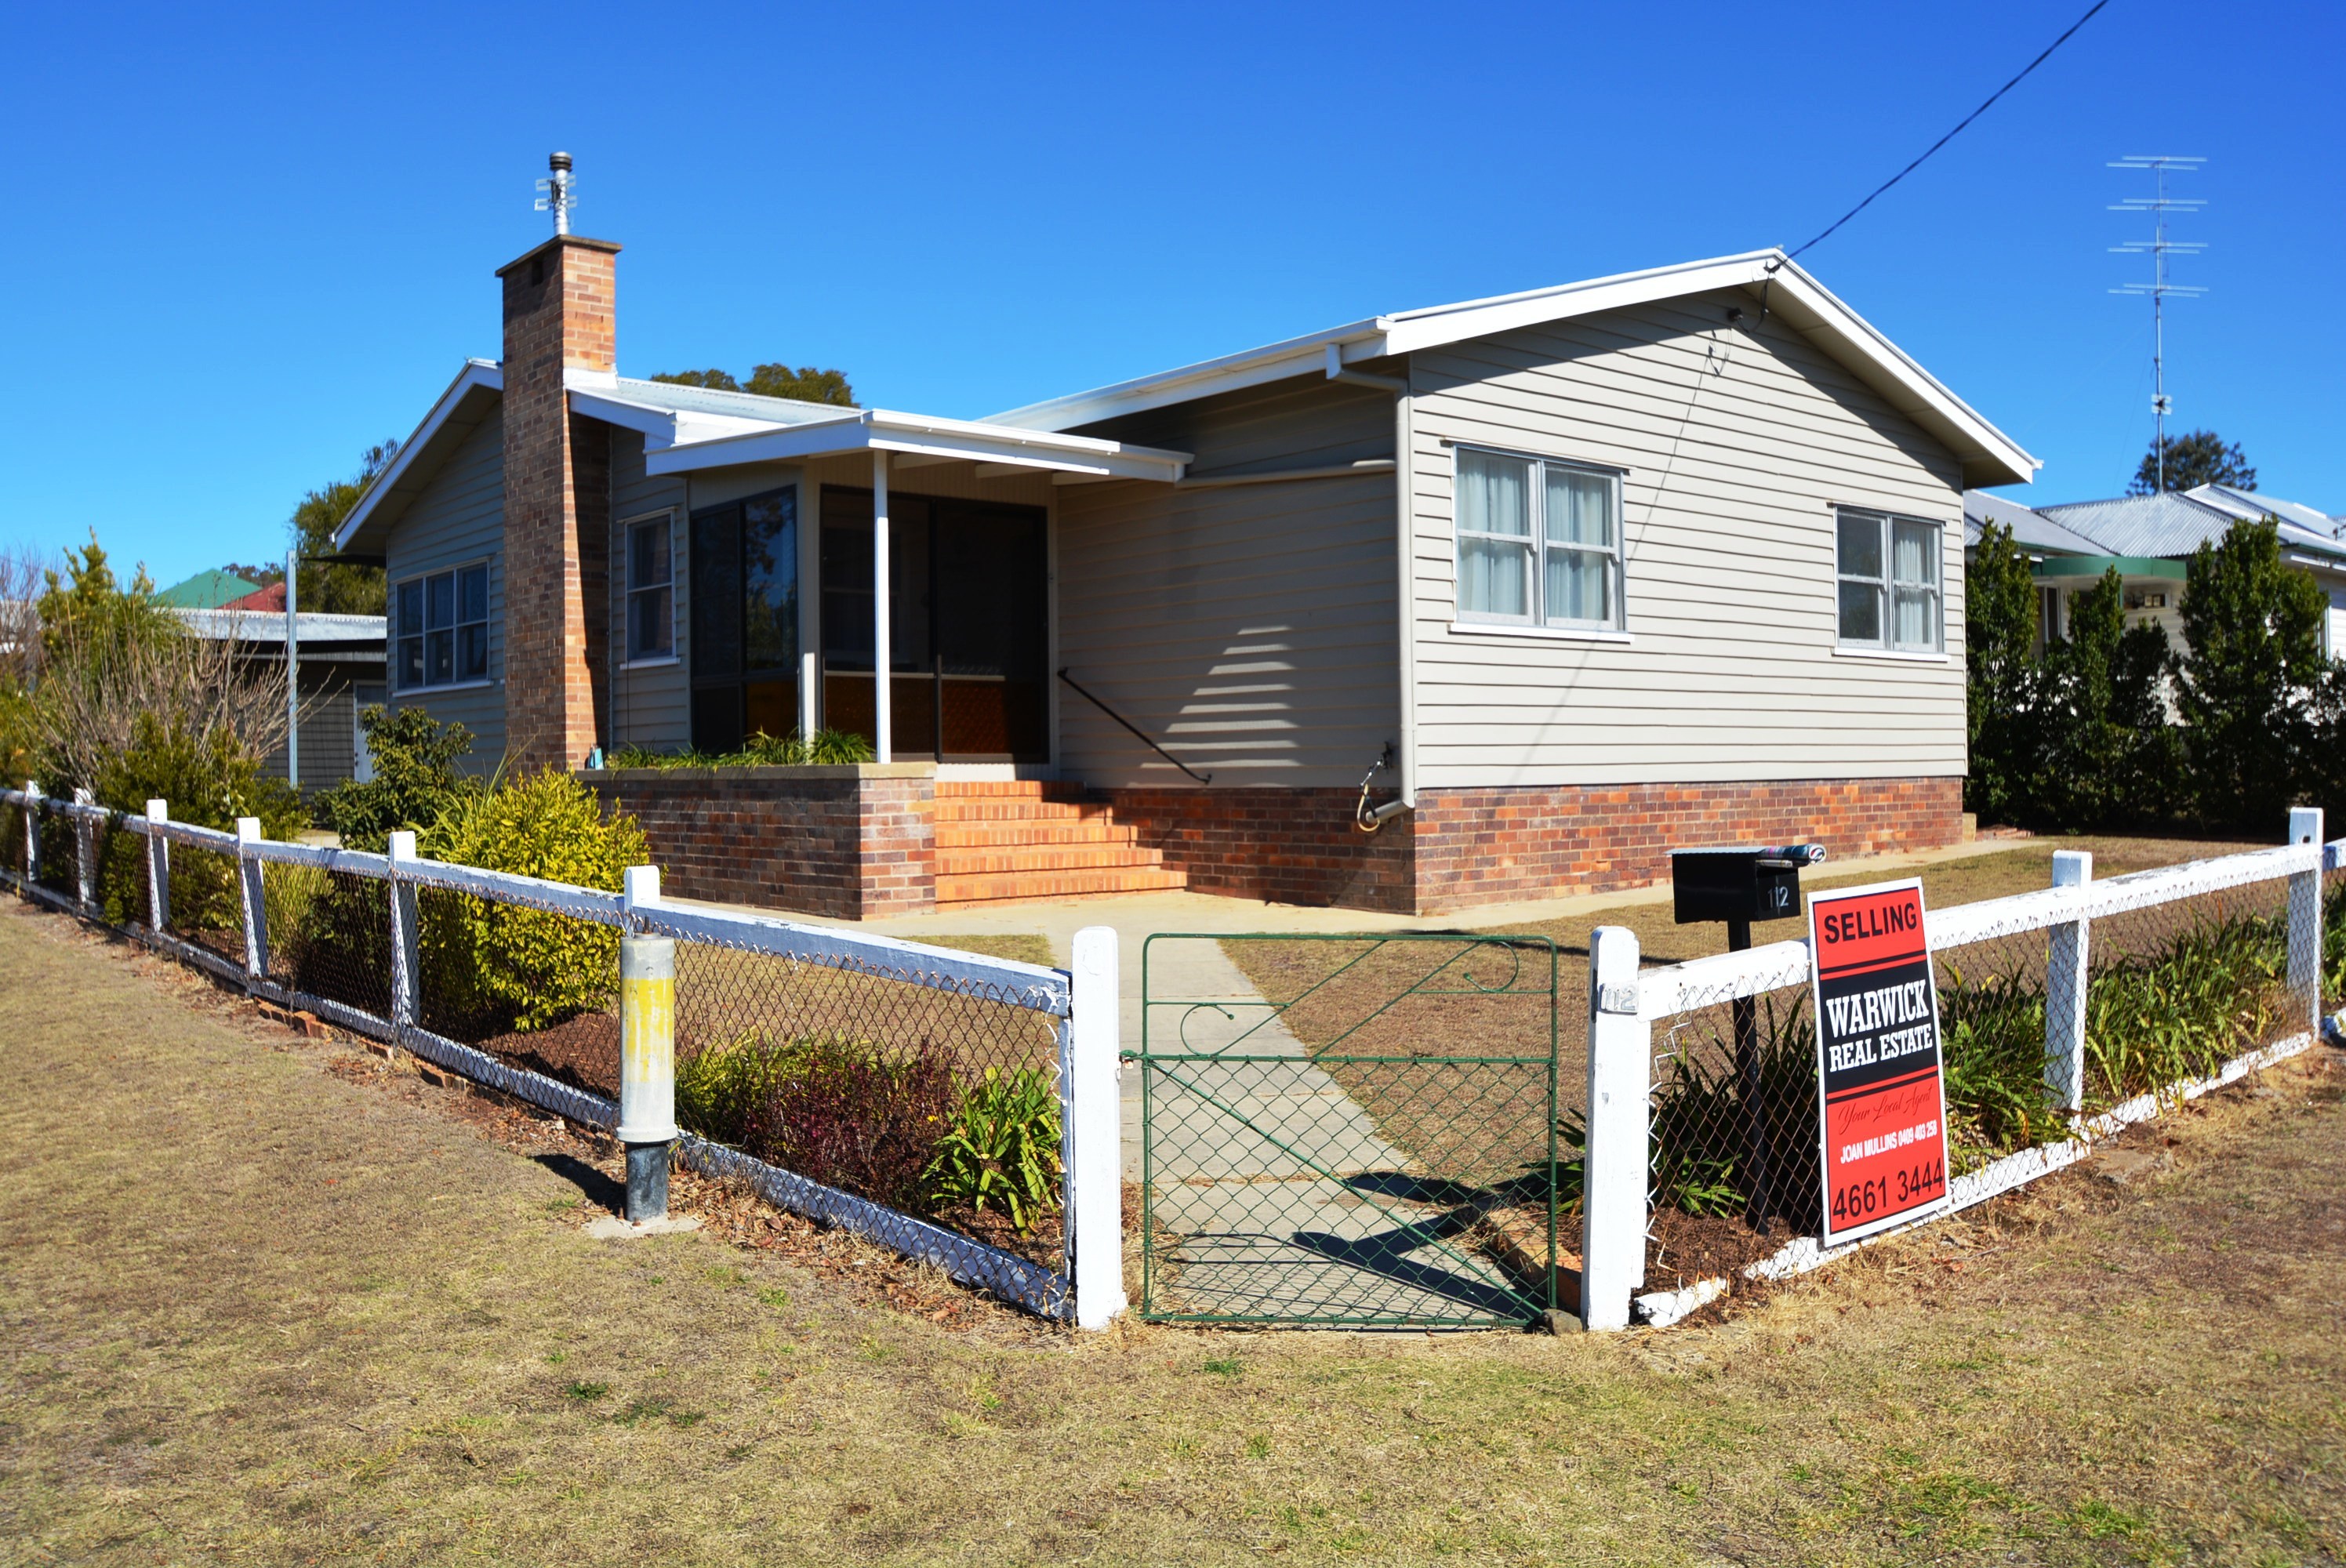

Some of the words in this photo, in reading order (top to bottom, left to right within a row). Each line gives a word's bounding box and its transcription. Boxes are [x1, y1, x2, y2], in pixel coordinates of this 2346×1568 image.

[1824, 902, 1917, 944] SELLING
[1825, 979, 1930, 1038] WARWICK
[1828, 1038, 1877, 1073] REAL
[1879, 1023, 1933, 1062] ESTATE
[1838, 1102, 1871, 1136] Your
[1872, 1092, 1905, 1123] Local
[1902, 1083, 1934, 1116] Agent
[1840, 1142, 1864, 1164] JOAN
[1864, 1131, 1898, 1157] MULLINS
[1898, 1127, 1914, 1147] 0409
[1914, 1123, 1927, 1142] 403
[1926, 1120, 1937, 1138] 258
[1832, 1176, 1887, 1221] 4661
[1897, 1156, 1944, 1203] 3444
